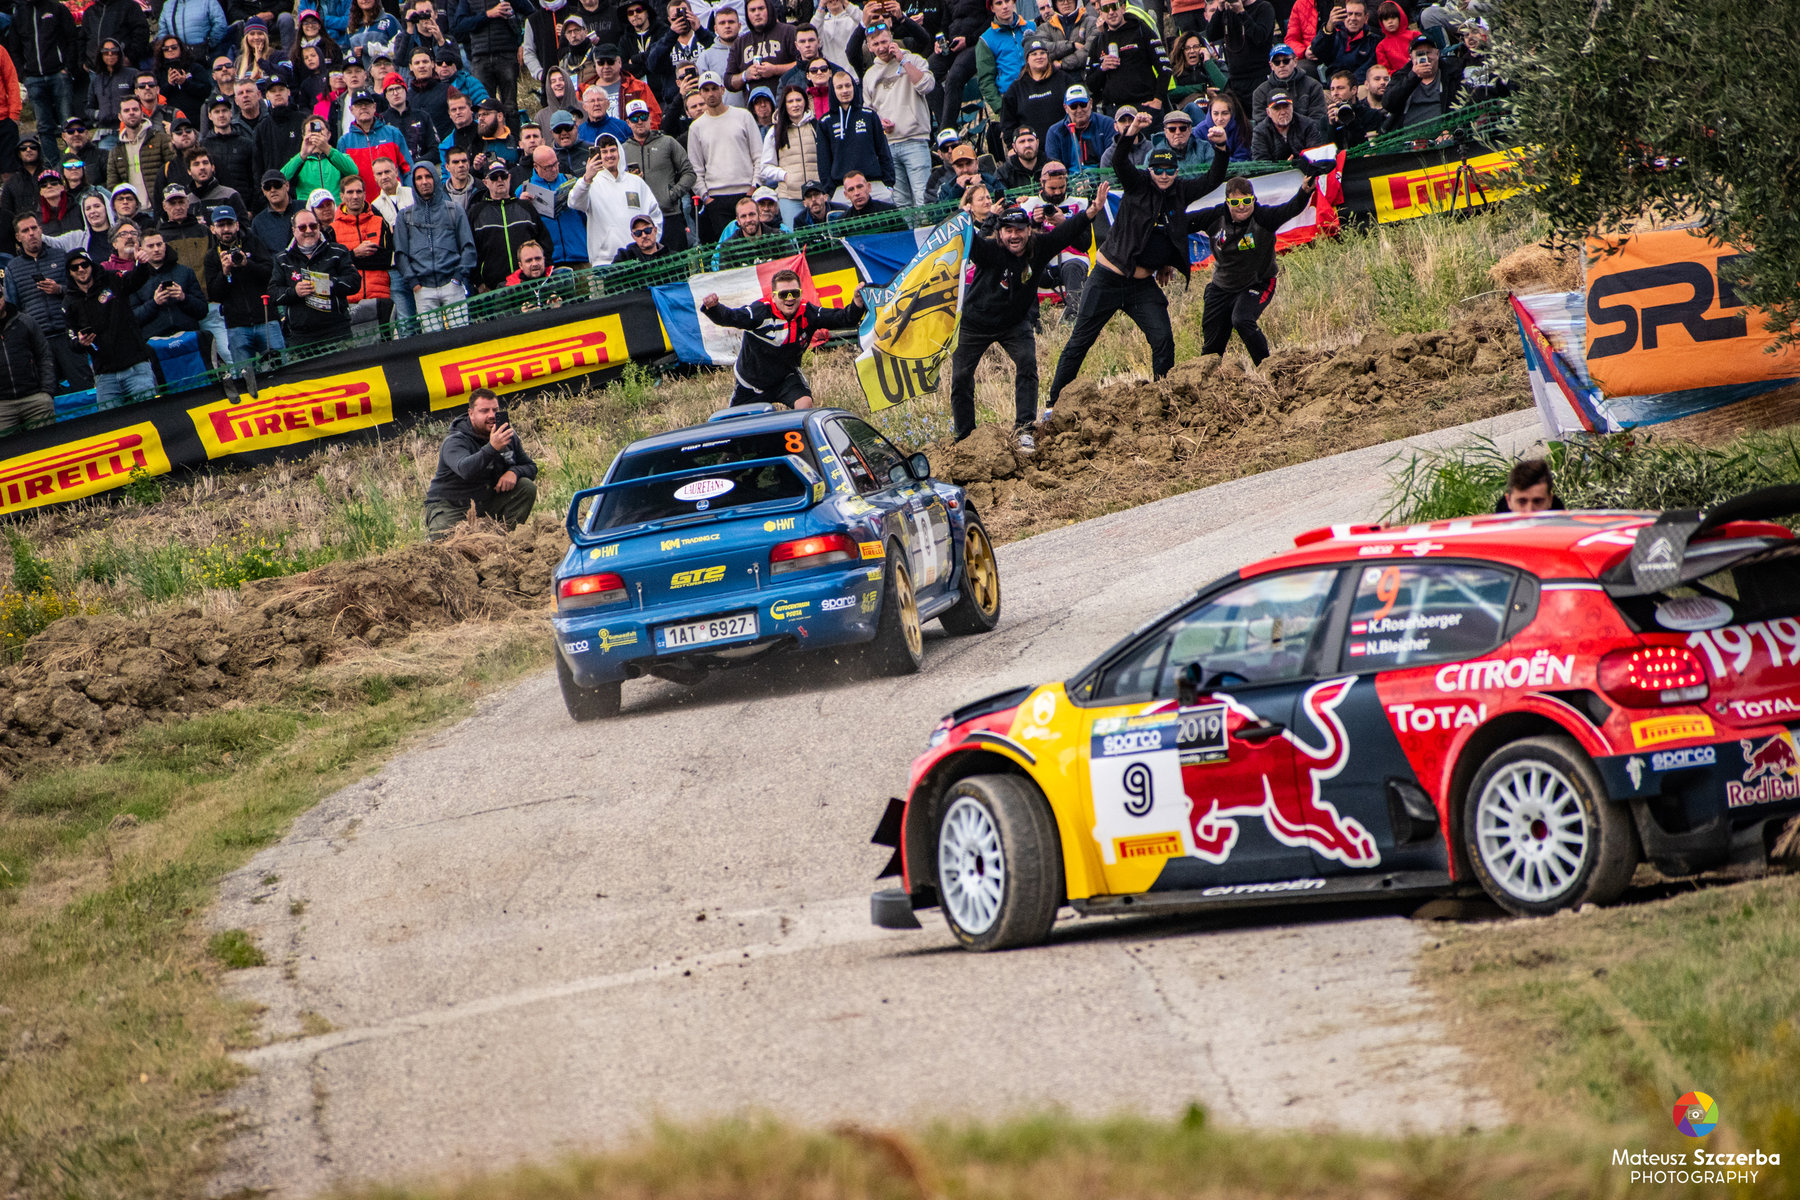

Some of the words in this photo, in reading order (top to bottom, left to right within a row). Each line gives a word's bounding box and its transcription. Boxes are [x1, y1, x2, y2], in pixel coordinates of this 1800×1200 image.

[743, 39, 781, 64] GAP
[440, 331, 609, 397] PIRELLI
[208, 382, 373, 444] PIRELLI
[784, 431, 805, 453] 8
[684, 480, 724, 494] LAURETANA
[775, 517, 796, 531] HWT
[602, 544, 620, 558] HWT
[660, 538, 681, 551] KM
[861, 544, 883, 557] PIRELLI
[669, 577, 723, 590] MOTORSPORT
[670, 565, 727, 586] GT2
[821, 595, 857, 610] sparco
[1373, 565, 1401, 620] 9
[669, 625, 696, 645] 1AT
[709, 618, 747, 638] 6927
[1686, 617, 1800, 678] 1919
[1435, 650, 1575, 692] CITROËN
[1729, 697, 1800, 718] TOTAL
[1175, 715, 1221, 743] 2019
[1640, 720, 1706, 740] PIRELLI
[1103, 730, 1162, 755] sparco
[1652, 746, 1716, 770] sparco
[1123, 762, 1154, 817] 9
[1727, 775, 1769, 808] Red
[1769, 773, 1800, 802] Bul
[1119, 836, 1179, 859] PIRELLI
